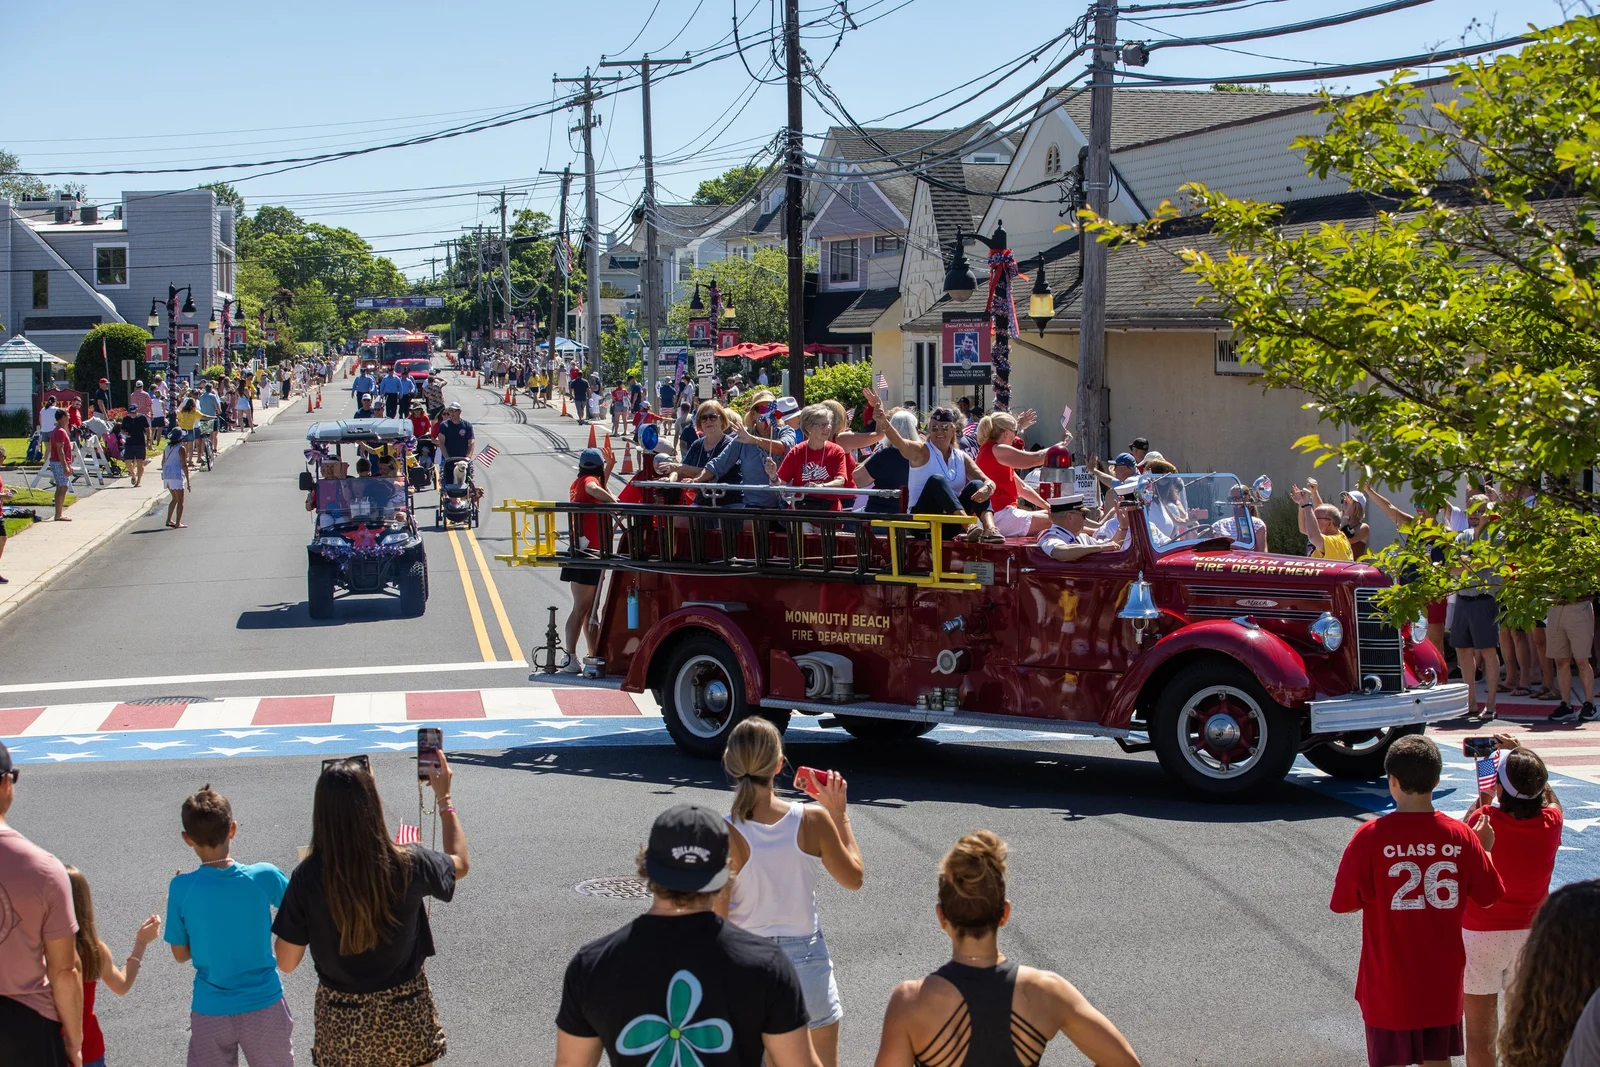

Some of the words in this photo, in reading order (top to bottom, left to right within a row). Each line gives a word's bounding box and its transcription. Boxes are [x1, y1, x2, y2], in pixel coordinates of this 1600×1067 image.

[697, 364, 713, 374] 25
[1191, 556, 1279, 565] MONMOUTH
[1284, 560, 1336, 568] BEACH
[1194, 562, 1226, 572] FIRE
[1231, 564, 1324, 576] DEPARTMENT
[785, 610, 848, 625] MONMOUTH
[852, 614, 890, 628] BEACH
[792, 629, 814, 641] FIRE
[818, 631, 884, 645] DEPARTMENT
[1383, 843, 1436, 858] CLASS
[1441, 843, 1462, 857] OF
[1388, 861, 1459, 910] 26
